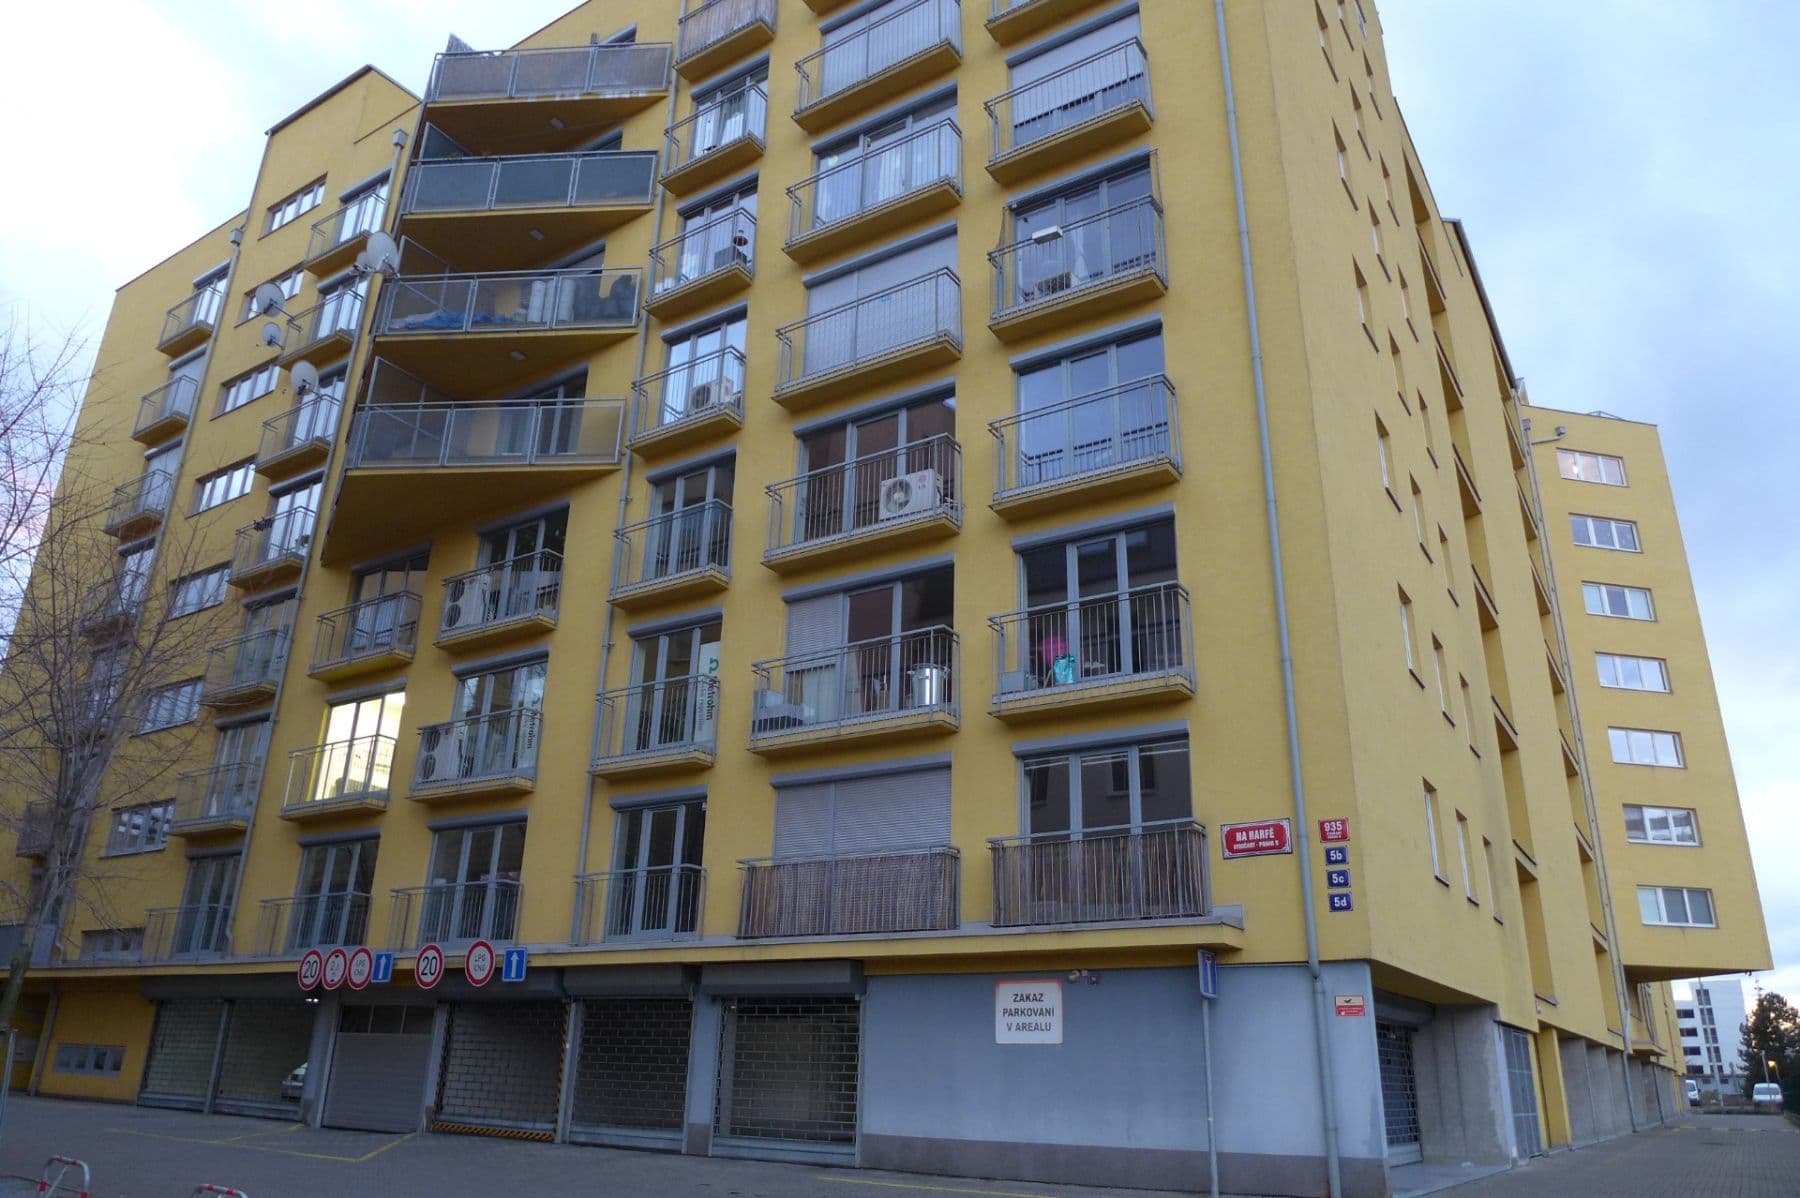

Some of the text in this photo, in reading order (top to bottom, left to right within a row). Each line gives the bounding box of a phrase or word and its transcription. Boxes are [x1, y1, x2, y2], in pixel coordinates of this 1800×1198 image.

[1324, 821, 1342, 832] 935
[1236, 831, 1247, 841] NA
[1330, 850, 1342, 860] 5b
[1332, 873, 1344, 883] 5c
[1334, 896, 1347, 907] 5d
[302, 961, 318, 978] 20
[421, 956, 438, 976] 20
[1006, 1022, 1013, 1031] V
